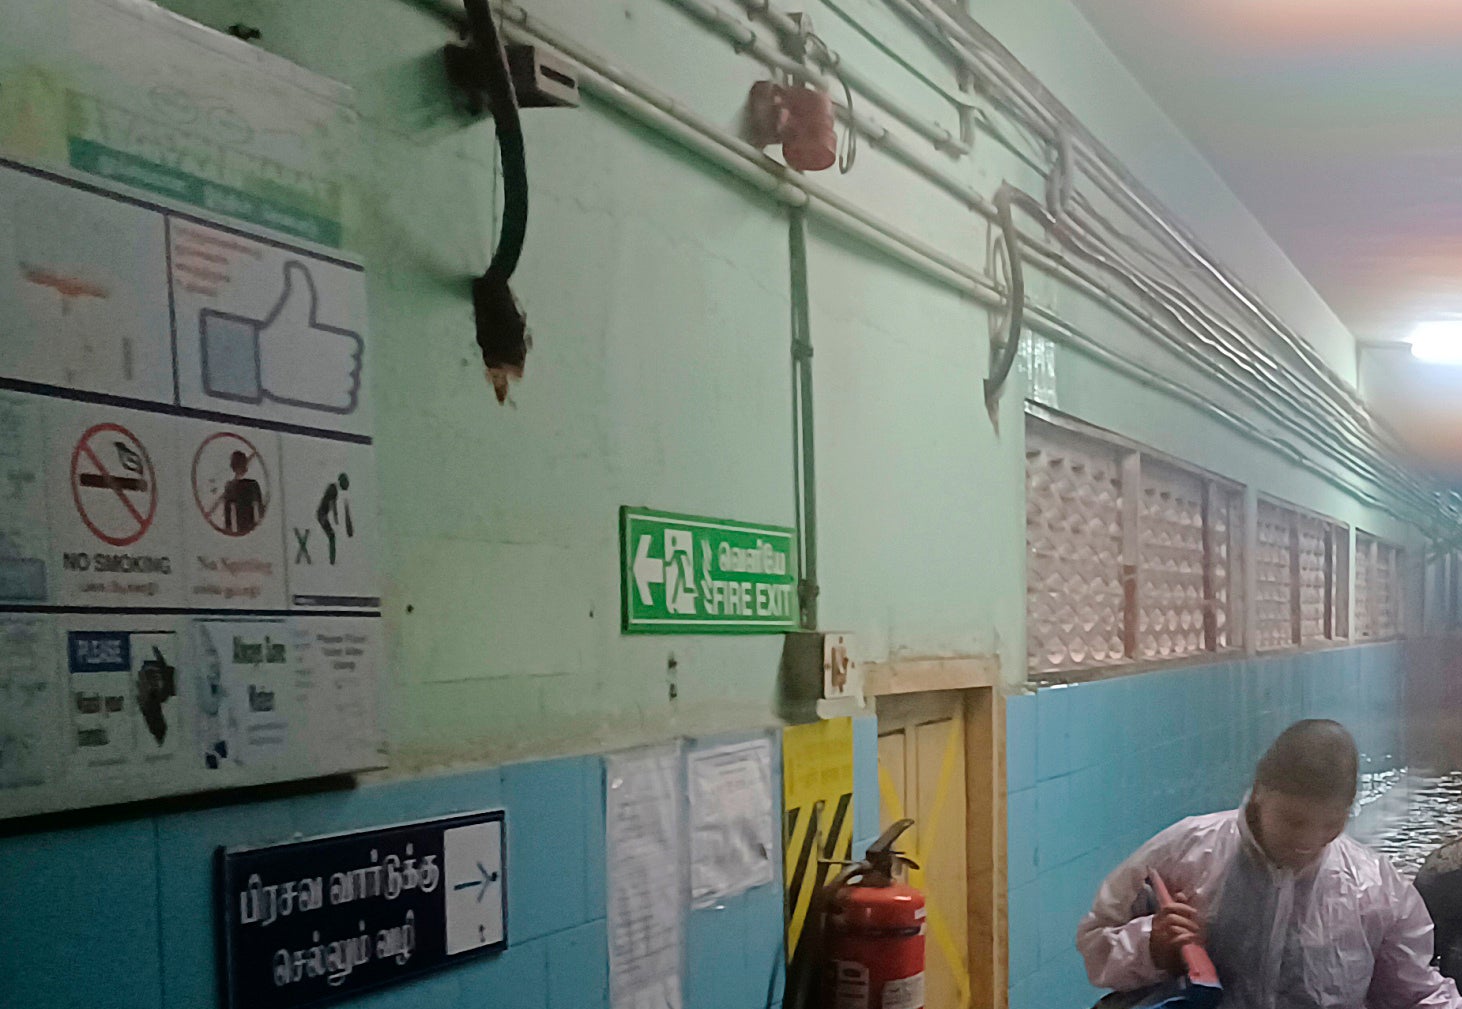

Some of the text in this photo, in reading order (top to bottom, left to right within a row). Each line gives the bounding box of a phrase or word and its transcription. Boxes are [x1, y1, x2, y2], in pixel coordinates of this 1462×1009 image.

[63, 553, 171, 575] NO SMOKING
[713, 581, 791, 616] FIRE EXIT
[240, 873, 322, 927] பிரசவ
[273, 909, 416, 986] செல்லும் வழி
